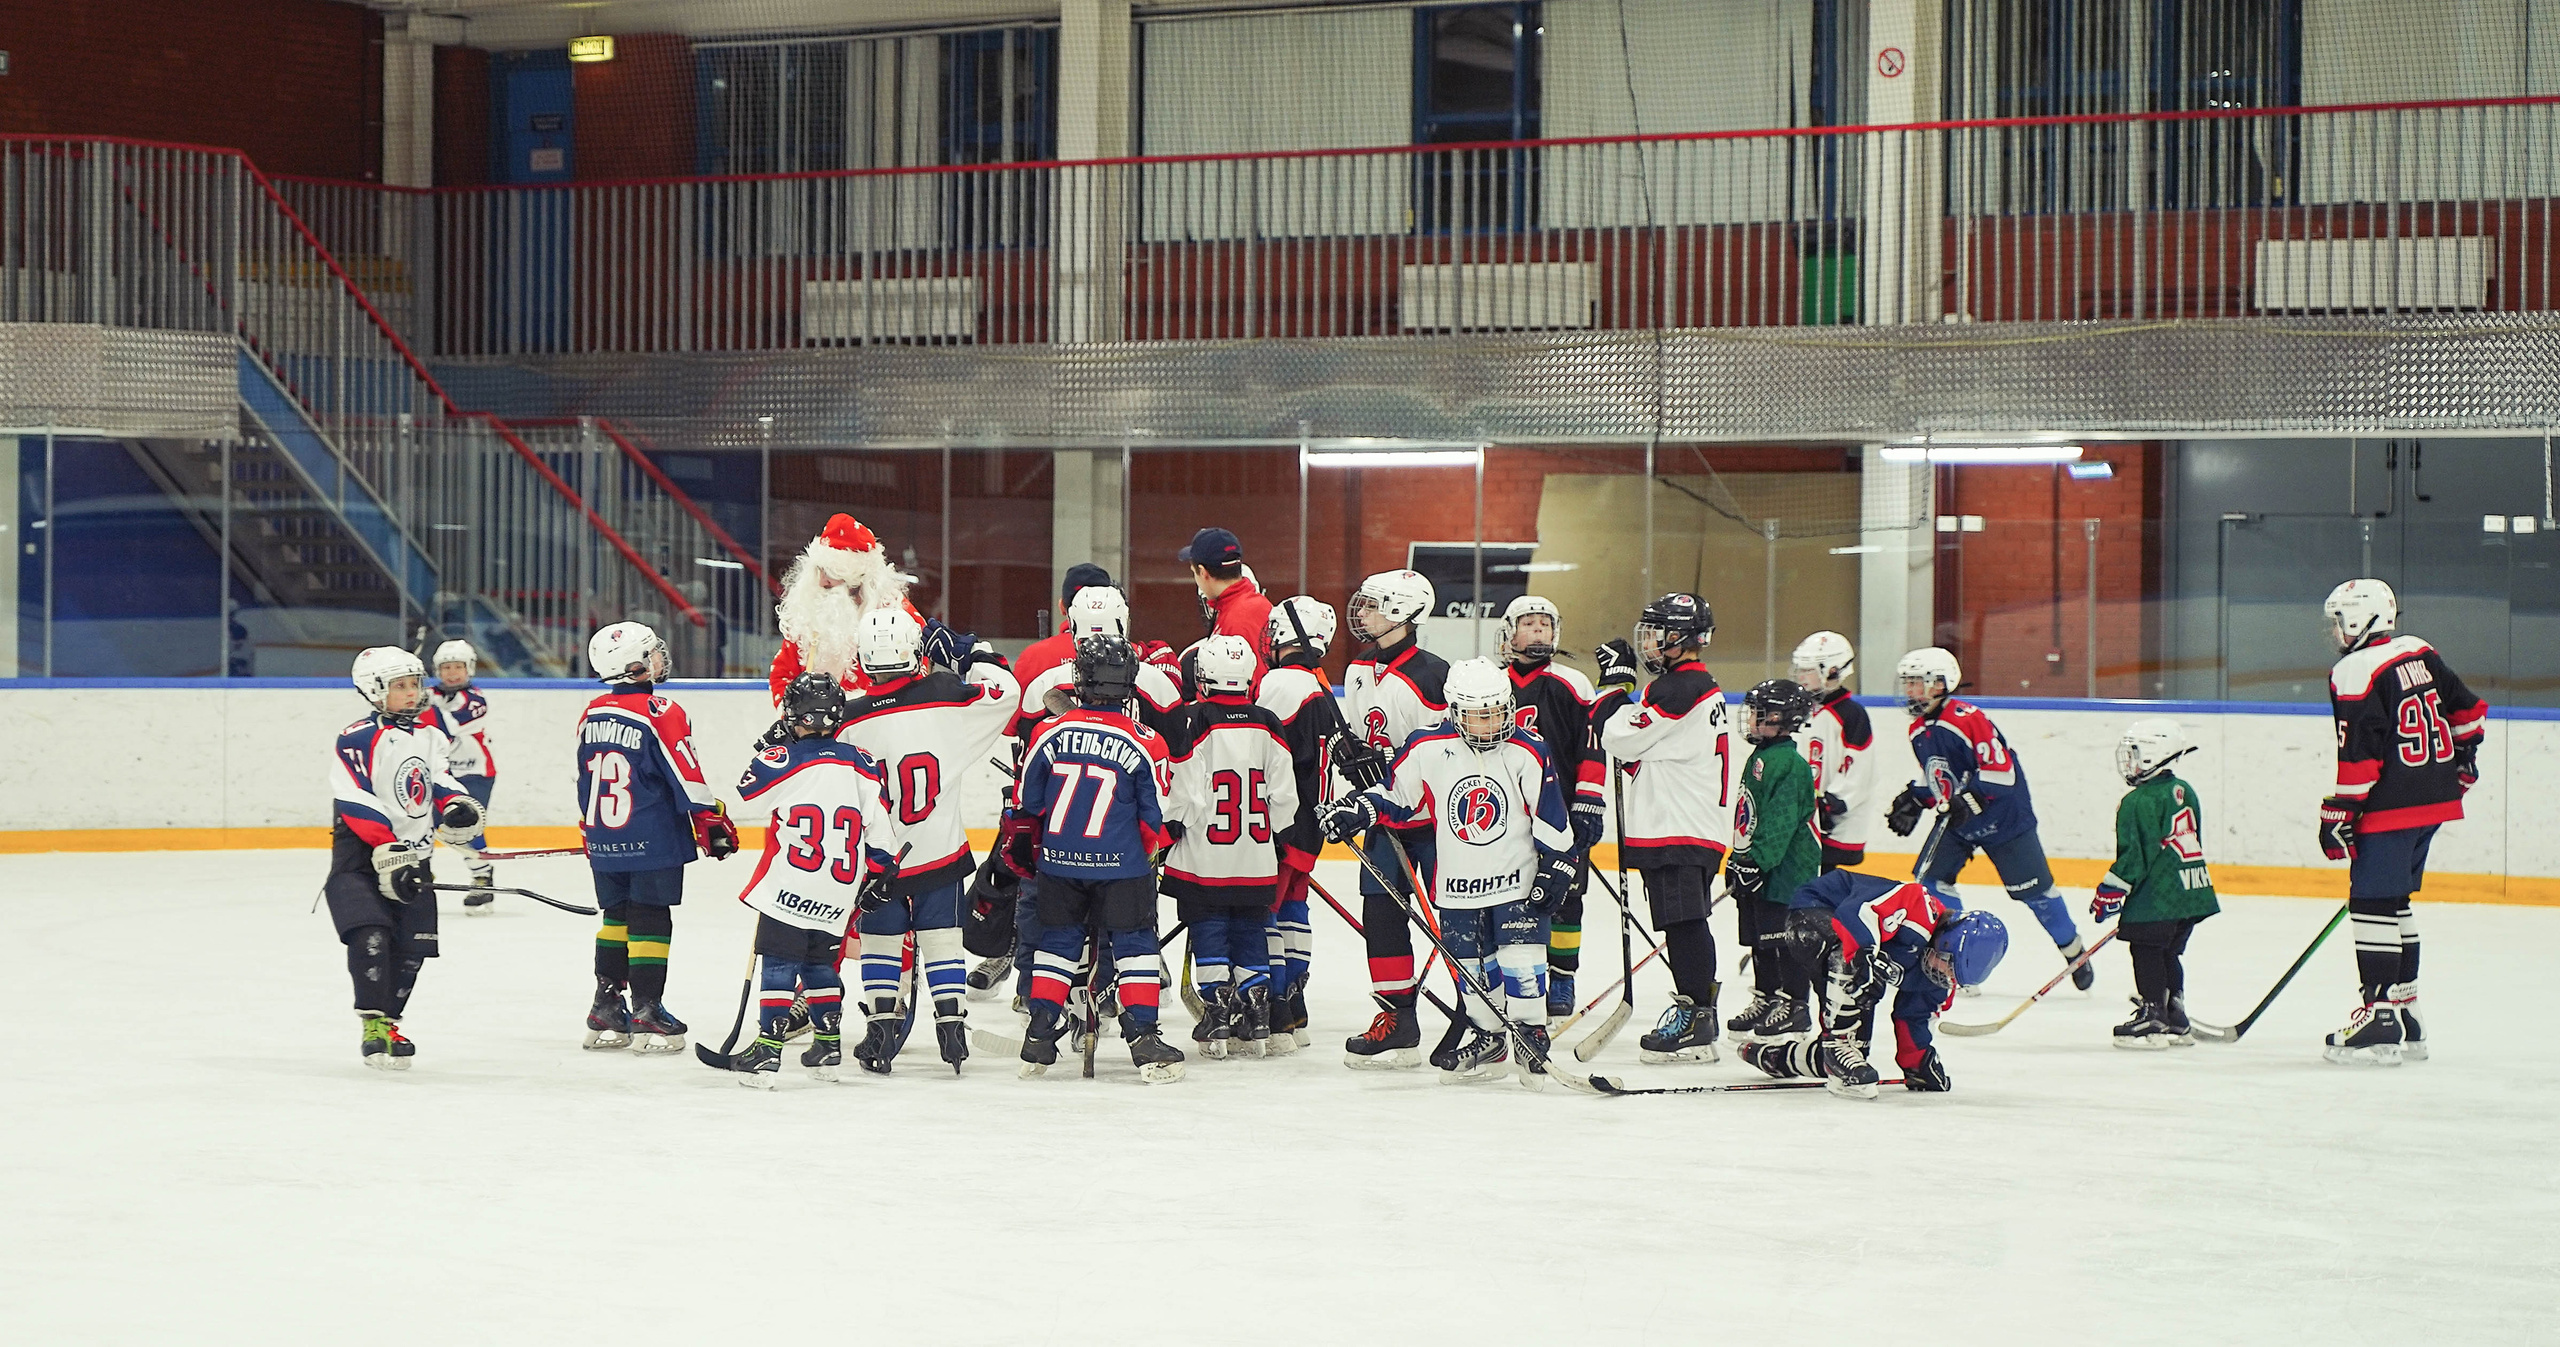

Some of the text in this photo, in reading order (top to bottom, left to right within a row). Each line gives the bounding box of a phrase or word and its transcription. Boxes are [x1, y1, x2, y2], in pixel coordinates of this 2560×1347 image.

[1091, 600, 1103, 610] 22
[1230, 650, 1241, 661] 35
[871, 698, 897, 708] LUTCH
[1226, 712, 1249, 720] LUTCH
[2397, 689, 2455, 768] 95
[586, 751, 632, 829] 13
[1048, 761, 1119, 838] 77
[1206, 768, 1272, 845] 35
[786, 803, 863, 885] 33
[1050, 849, 1121, 861] SPINETIX
[1445, 869, 1521, 894] КВАНТ-Н
[776, 889, 845, 920] КВАНТ-Н
